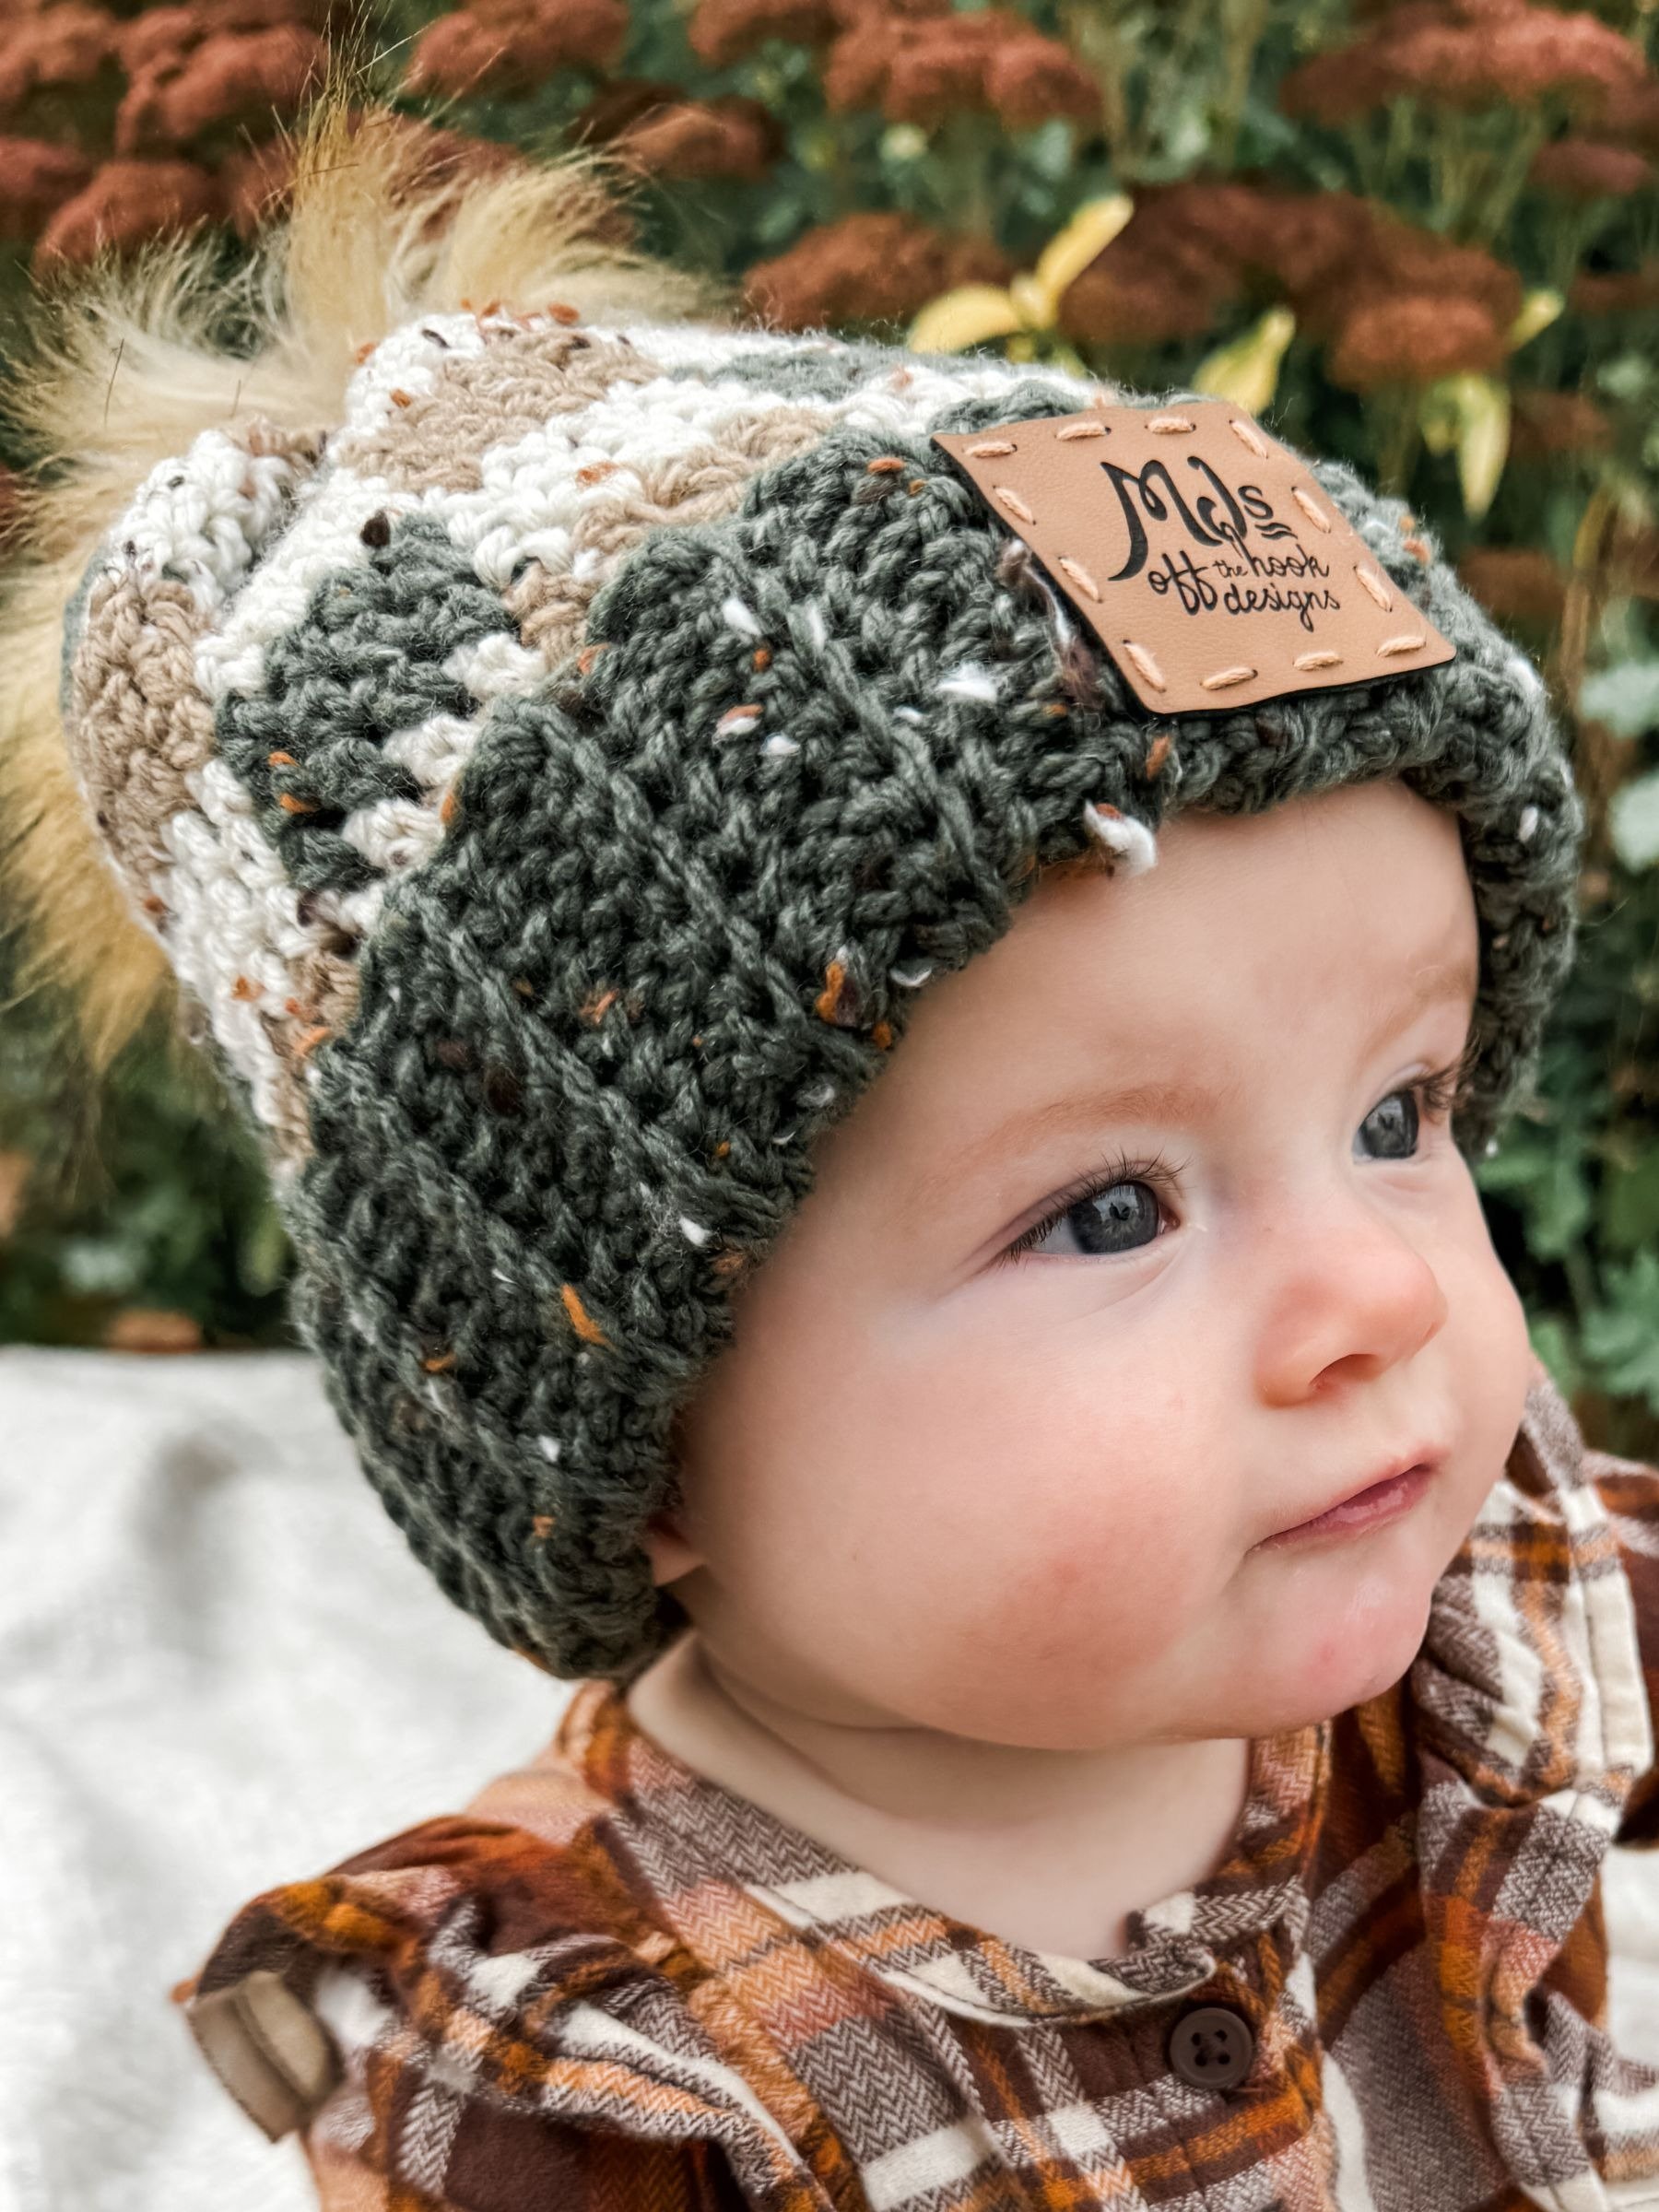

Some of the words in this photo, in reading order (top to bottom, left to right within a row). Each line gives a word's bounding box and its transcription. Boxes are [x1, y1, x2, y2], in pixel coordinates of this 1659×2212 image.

[1147, 549, 1218, 616] off
[1212, 559, 1247, 579] the
[1232, 531, 1329, 578] hook
[1224, 582, 1340, 632] designs
